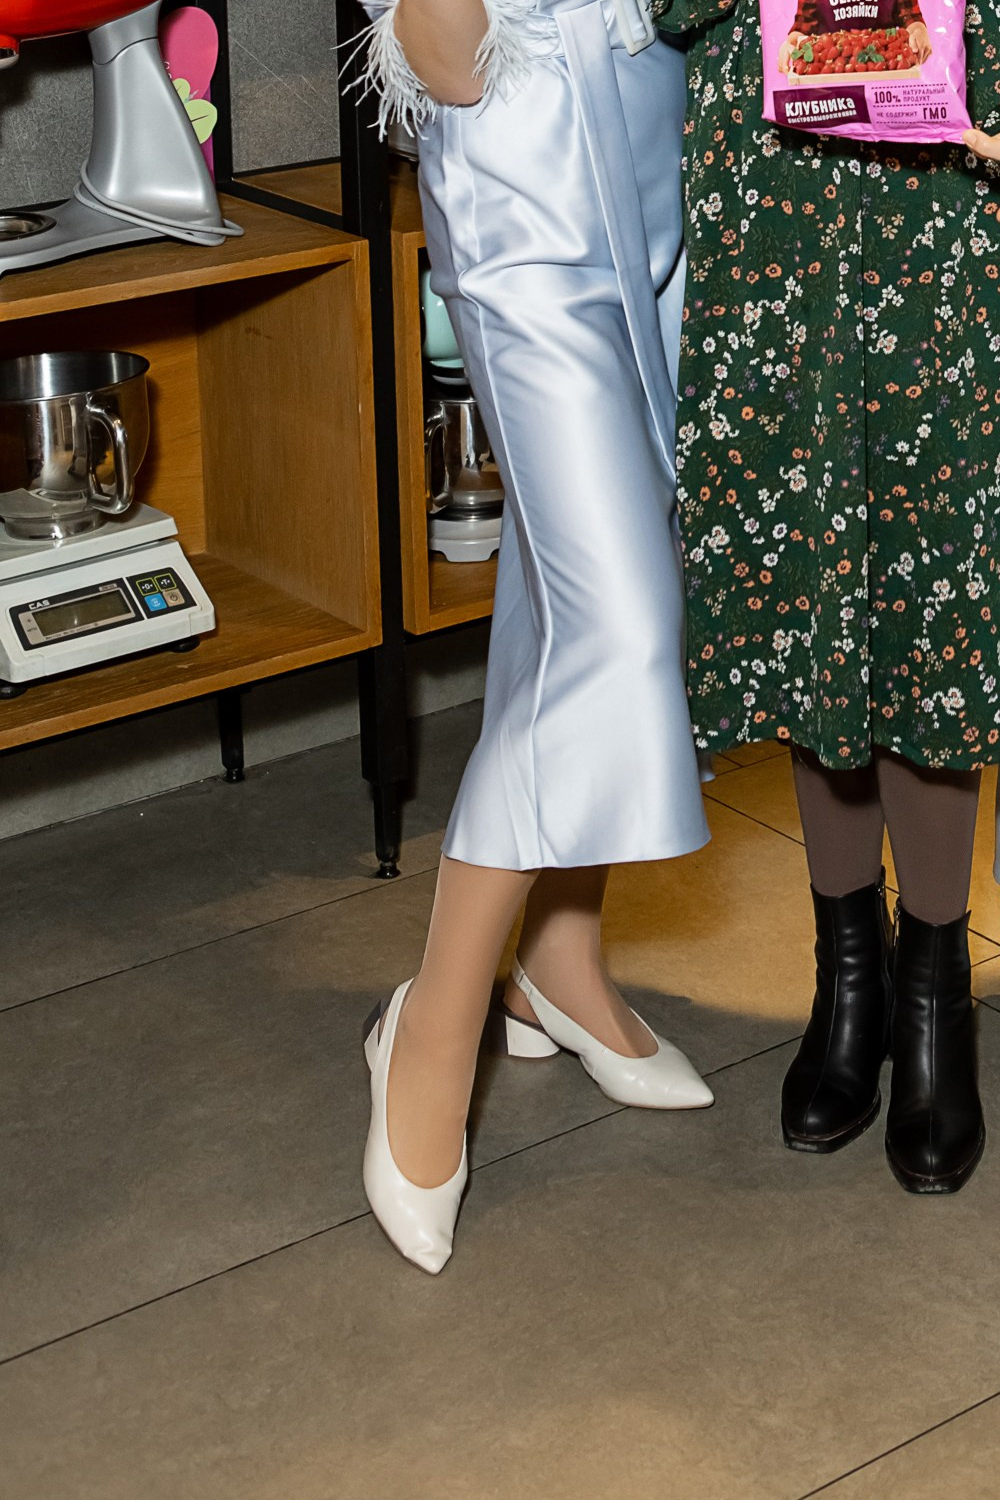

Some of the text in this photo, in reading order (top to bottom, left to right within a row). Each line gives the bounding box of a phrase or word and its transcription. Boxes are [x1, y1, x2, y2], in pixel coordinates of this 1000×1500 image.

[833, 1, 879, 22] ХОЗЯЙКИ
[873, 87, 946, 104] 100% НАТУРАЛЬНЫЙ
[902, 95, 931, 103] ПРОДУКТ
[922, 106, 947, 120] ГМО
[28, 599, 51, 611] CAS
